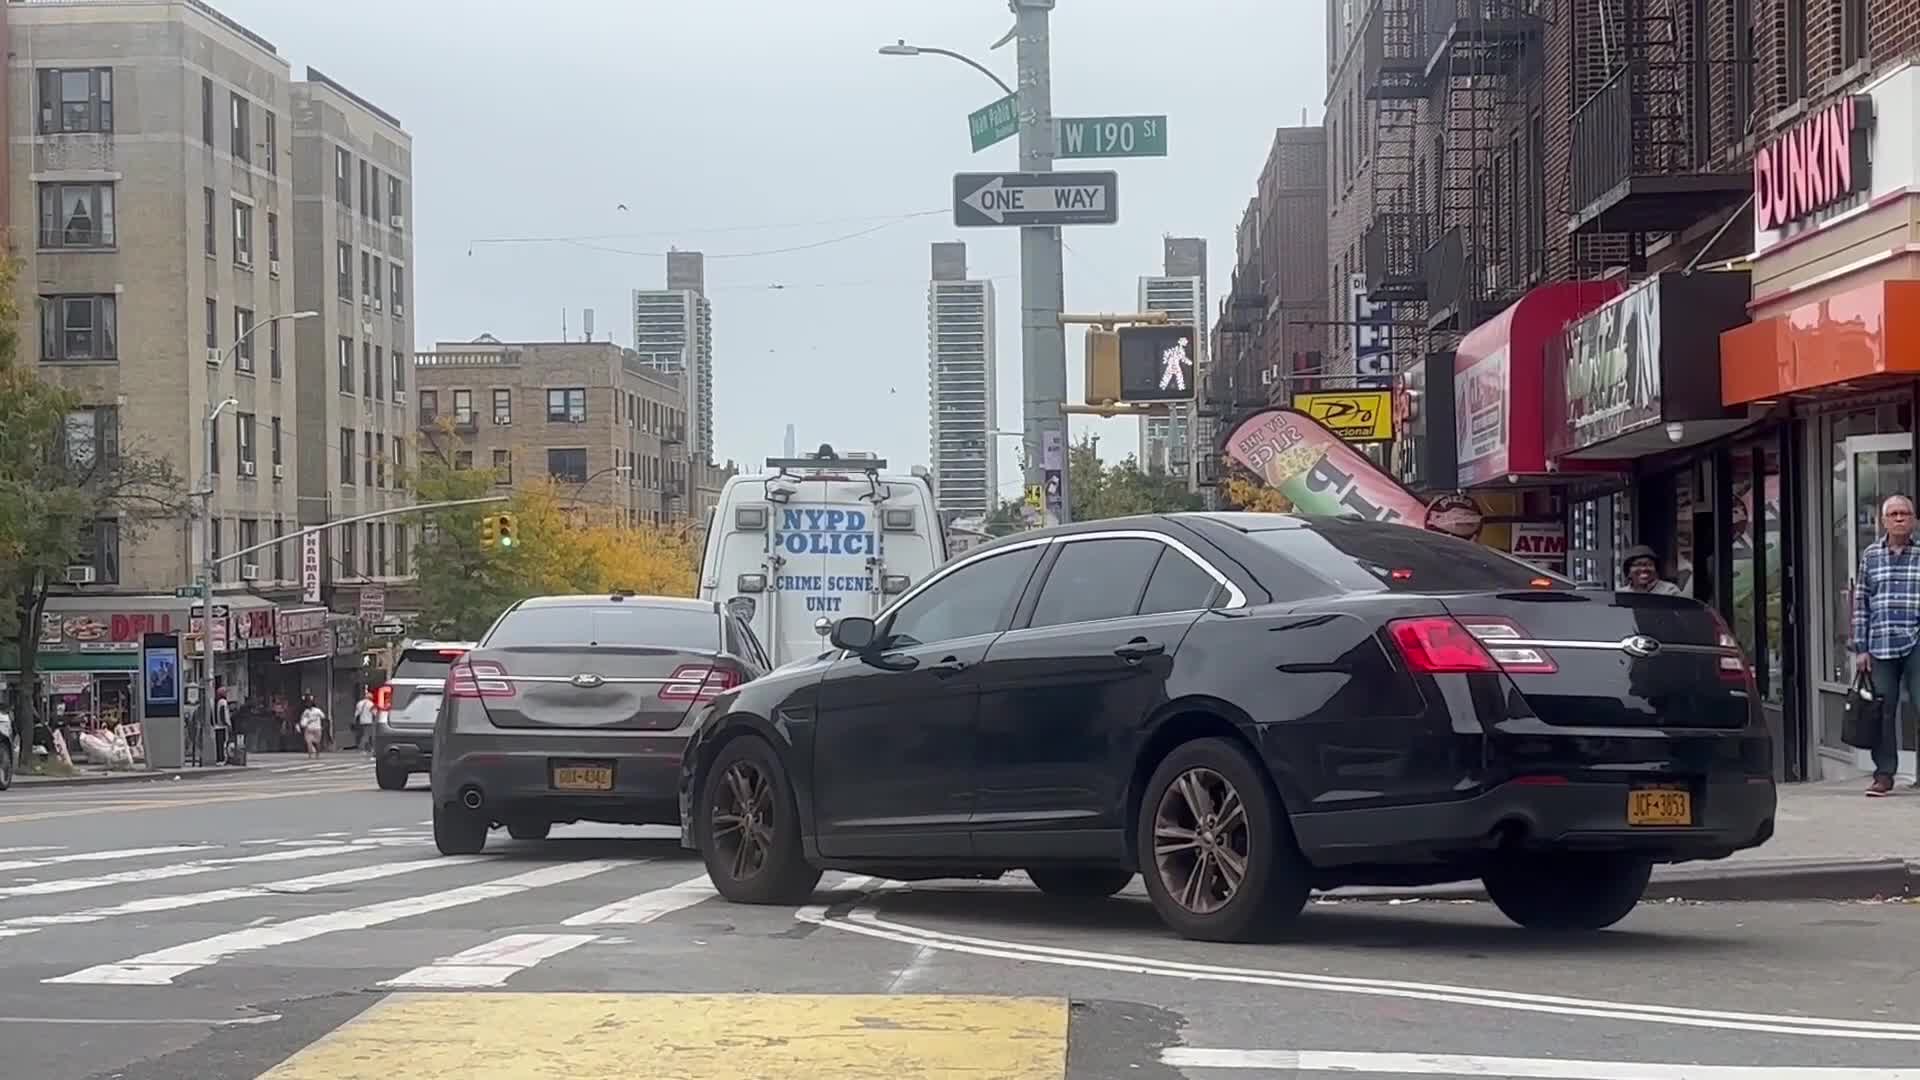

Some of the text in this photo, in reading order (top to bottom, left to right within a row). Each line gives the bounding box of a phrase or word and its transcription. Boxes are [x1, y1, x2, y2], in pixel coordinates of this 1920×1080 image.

[1066, 120, 1156, 152] W 190 St
[981, 188, 1099, 210] ONE WAY
[783, 509, 866, 531] NYPD
[1515, 535, 1568, 552] ATM
[776, 576, 873, 591] CRIME SCENE
[806, 597, 842, 612] UNIT
